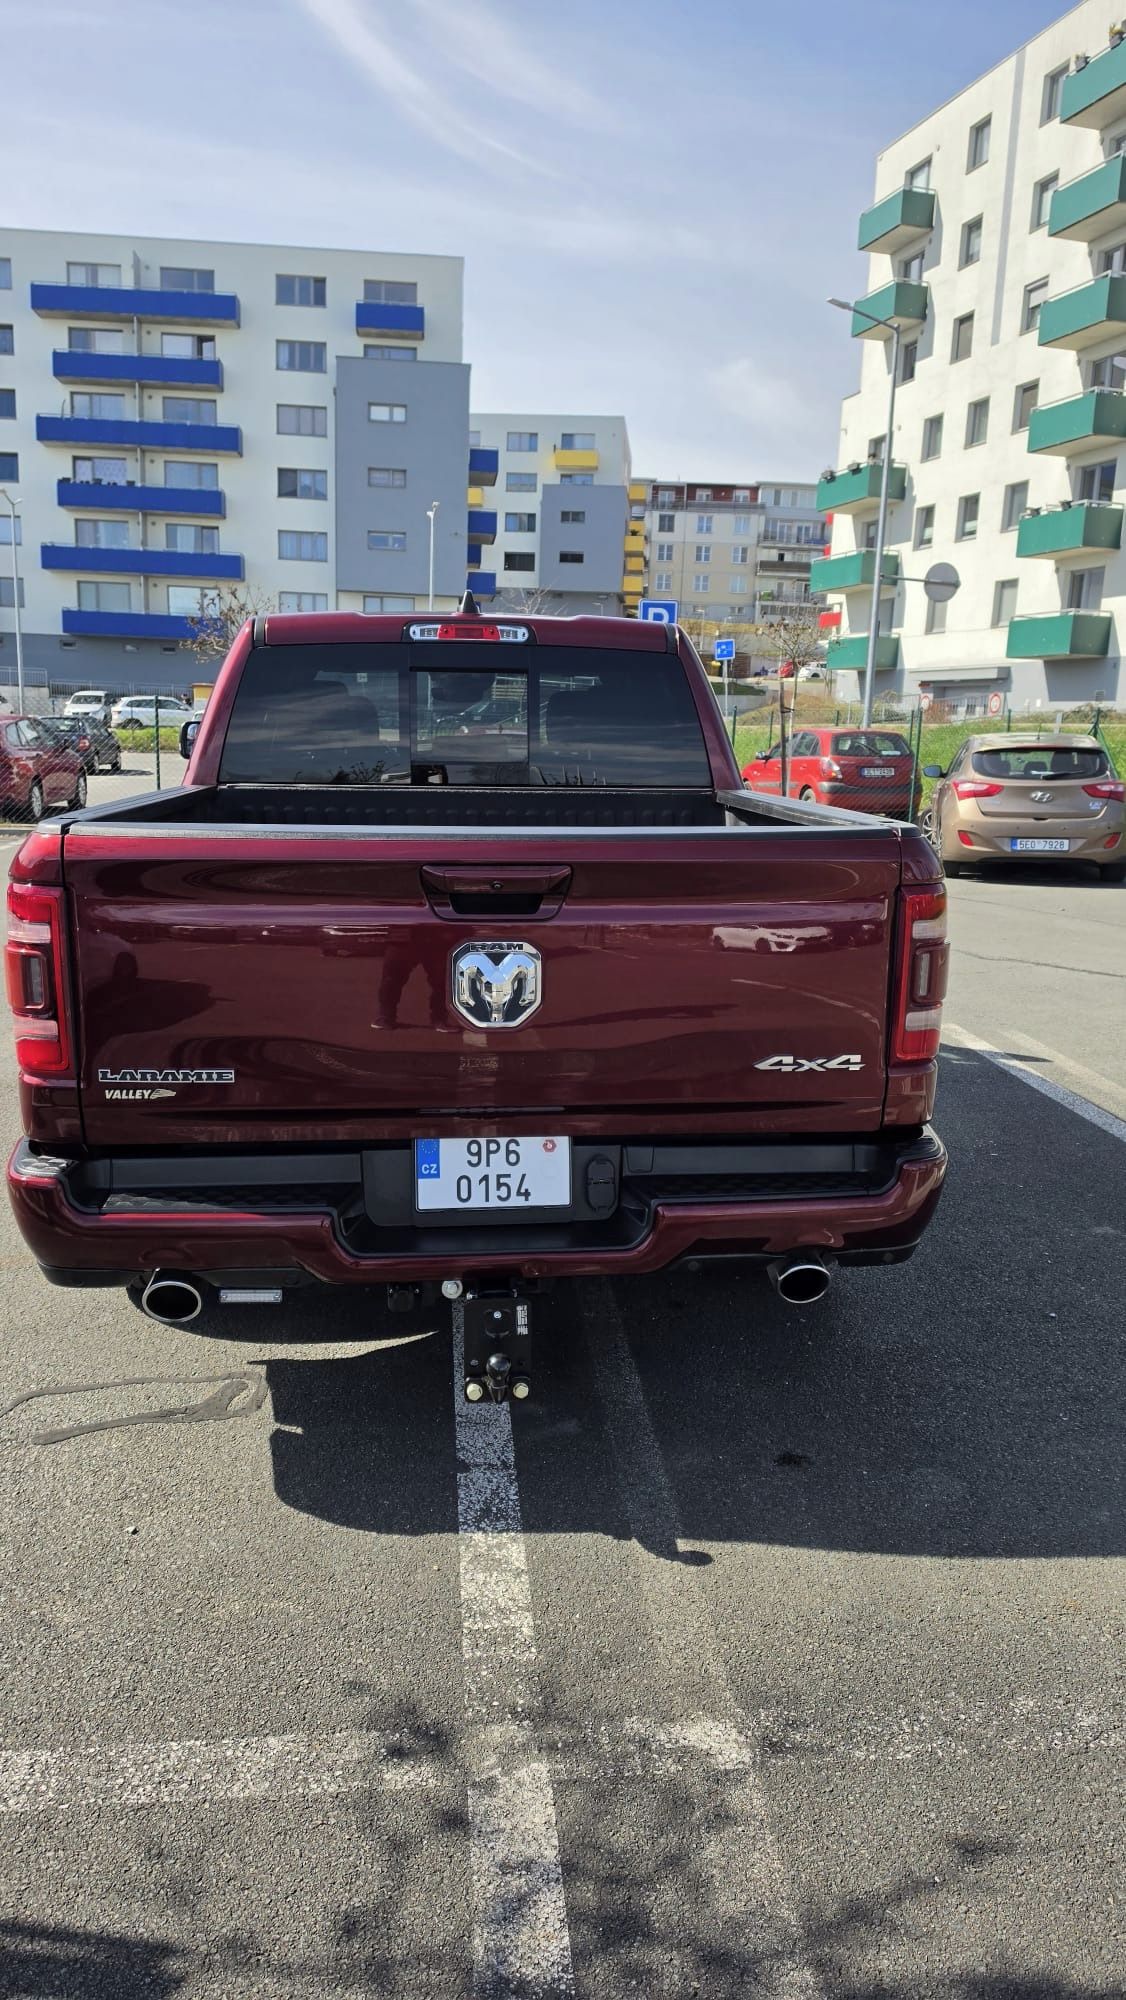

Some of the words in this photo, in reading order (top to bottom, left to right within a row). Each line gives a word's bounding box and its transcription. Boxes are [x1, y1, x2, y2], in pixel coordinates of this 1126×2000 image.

[1042, 840, 1065, 849] 7928
[469, 943, 524, 952] RAM
[98, 1069, 235, 1083] LARAMIE
[105, 1089, 152, 1100] VALLEY
[466, 1138, 521, 1168] 9P6
[421, 1163, 438, 1175] CZ
[456, 1173, 532, 1203] 0154
